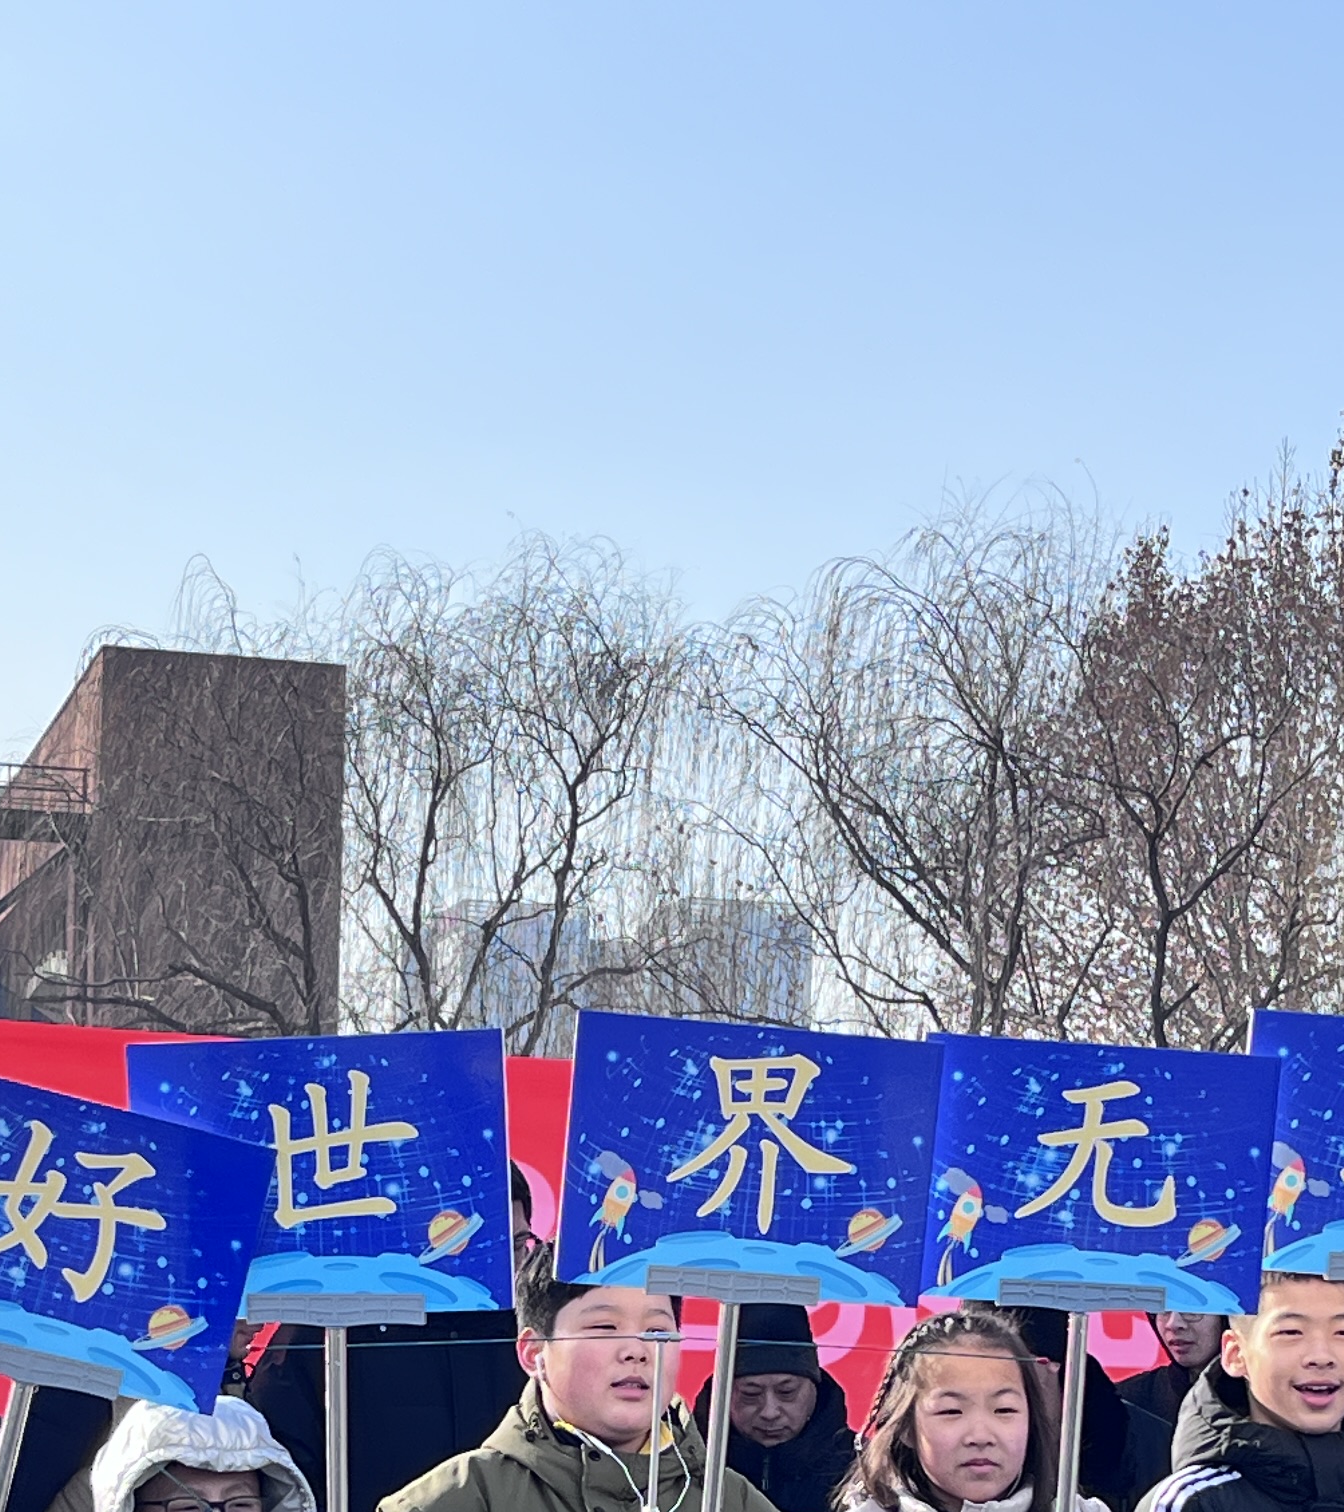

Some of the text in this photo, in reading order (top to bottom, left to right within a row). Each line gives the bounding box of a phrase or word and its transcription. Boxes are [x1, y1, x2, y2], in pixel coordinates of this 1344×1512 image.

[268, 1069, 419, 1230] 世
[667, 1053, 854, 1234] 界
[1015, 1080, 1177, 1228] 无
